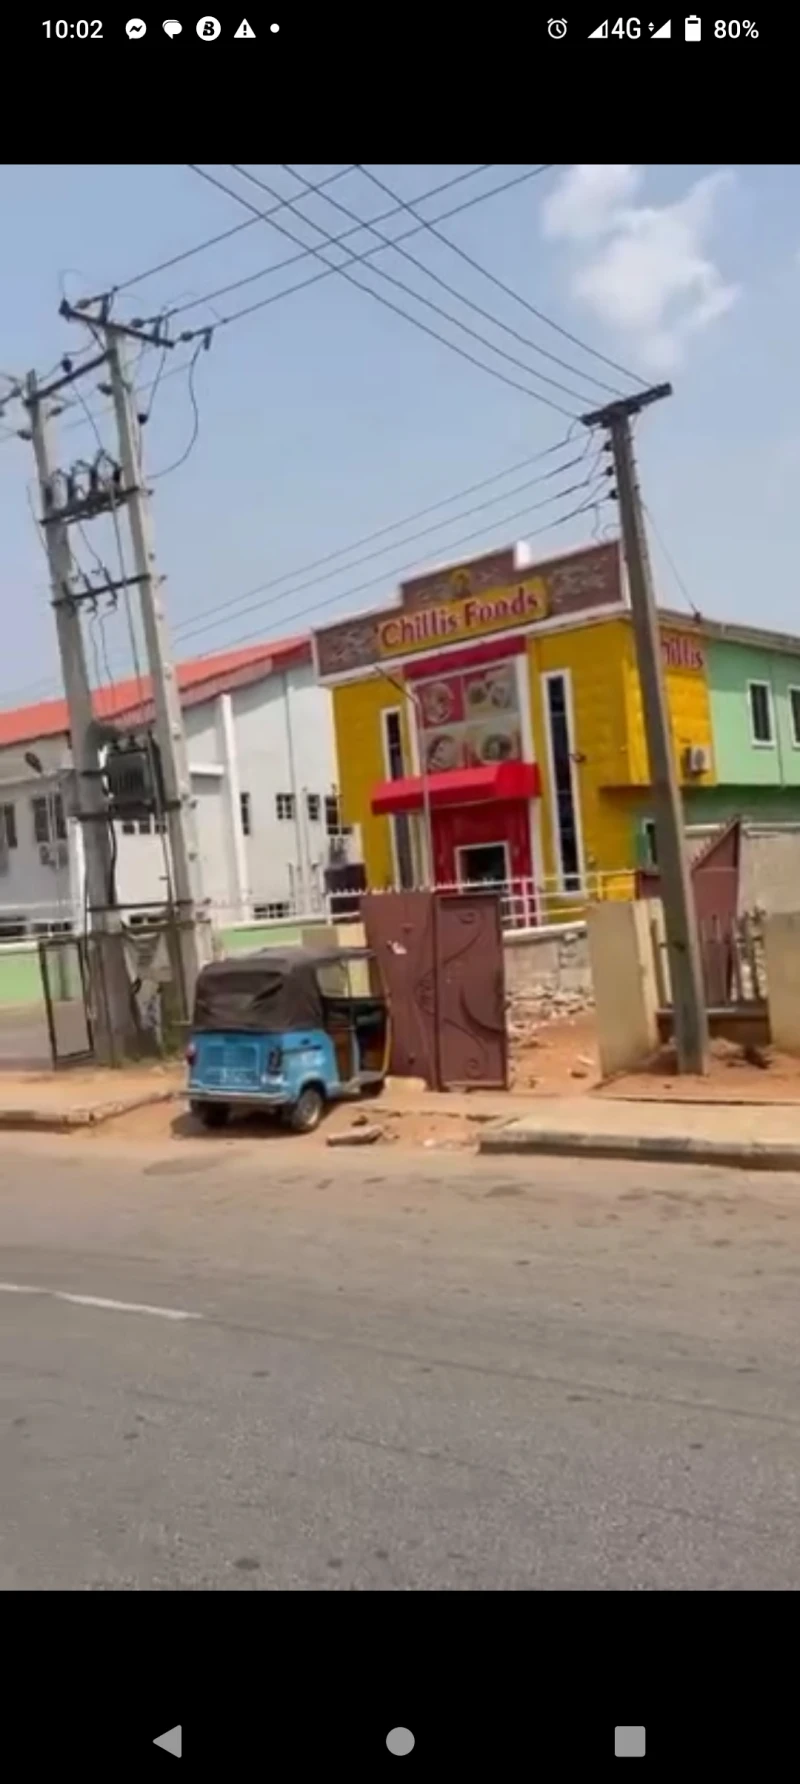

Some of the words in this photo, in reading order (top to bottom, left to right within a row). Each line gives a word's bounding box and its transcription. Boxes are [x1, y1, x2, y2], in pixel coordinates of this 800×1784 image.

[380, 609, 458, 649] Chillis
[464, 587, 538, 627] Foods
[660, 636, 704, 670] hillis
